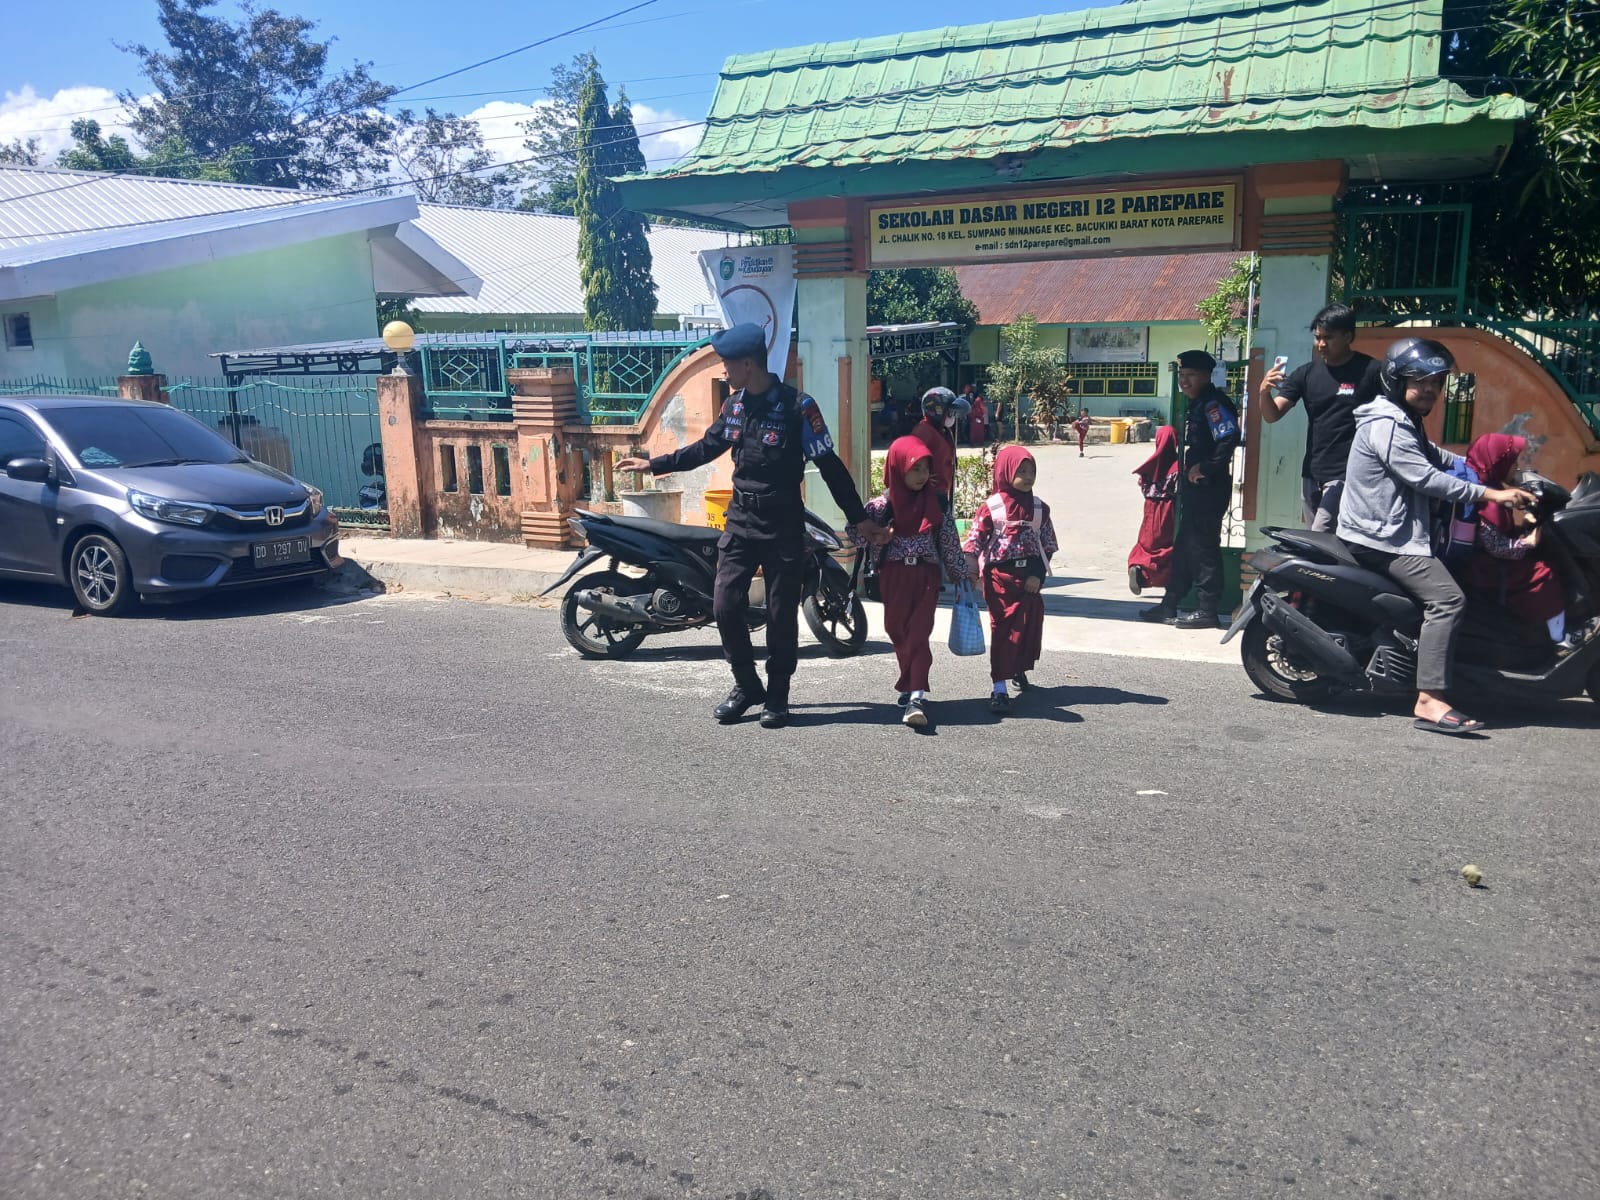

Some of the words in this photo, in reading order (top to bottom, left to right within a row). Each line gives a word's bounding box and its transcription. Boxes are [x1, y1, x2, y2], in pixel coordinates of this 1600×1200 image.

[879, 209, 954, 229] SEKOLAH
[960, 204, 1017, 224] DASAR
[1023, 200, 1089, 220] NEGERI
[1096, 198, 1115, 215] 12
[1122, 191, 1224, 213] PAREPARE
[879, 235, 890, 244] JL.
[892, 233, 919, 243] CHALIK
[922, 232, 934, 241] NO.
[937, 231, 946, 240] 18
[948, 230, 965, 240] KEL.
[968, 228, 1006, 239] SUMPANG
[1009, 225, 1052, 236] MINANGAE
[1054, 224, 1074, 233] KEC.
[1076, 220, 1118, 232] BACUKIKI
[1120, 219, 1149, 229] BARAT
[1151, 217, 1175, 228] KOTA
[1178, 215, 1224, 226] PAREPARE
[975, 241, 998, 250] e-mail
[1004, 236, 1111, 250] sdn12parepare@gmail.com
[255, 545, 267, 559] DD
[273, 542, 291, 556] 1297
